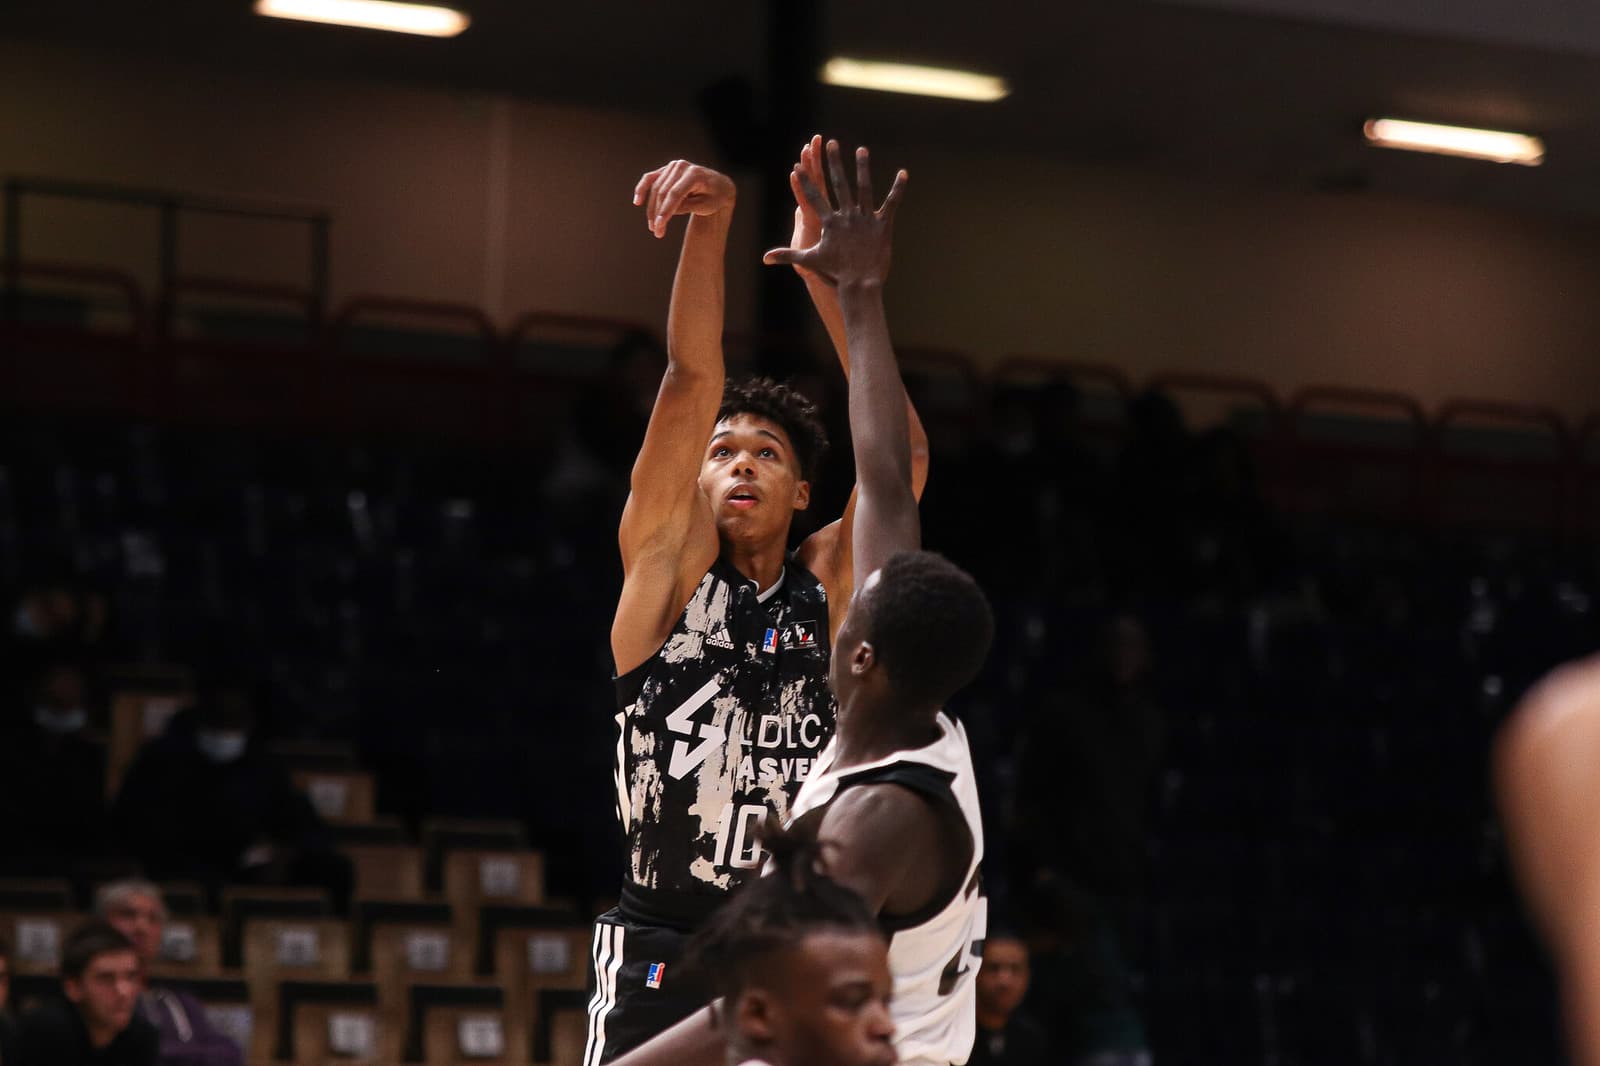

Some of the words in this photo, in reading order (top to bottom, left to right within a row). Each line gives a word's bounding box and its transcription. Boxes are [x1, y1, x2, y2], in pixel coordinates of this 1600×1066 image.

[705, 638, 735, 650] adidas
[739, 711, 822, 749] LDLC
[713, 803, 768, 869] 10
